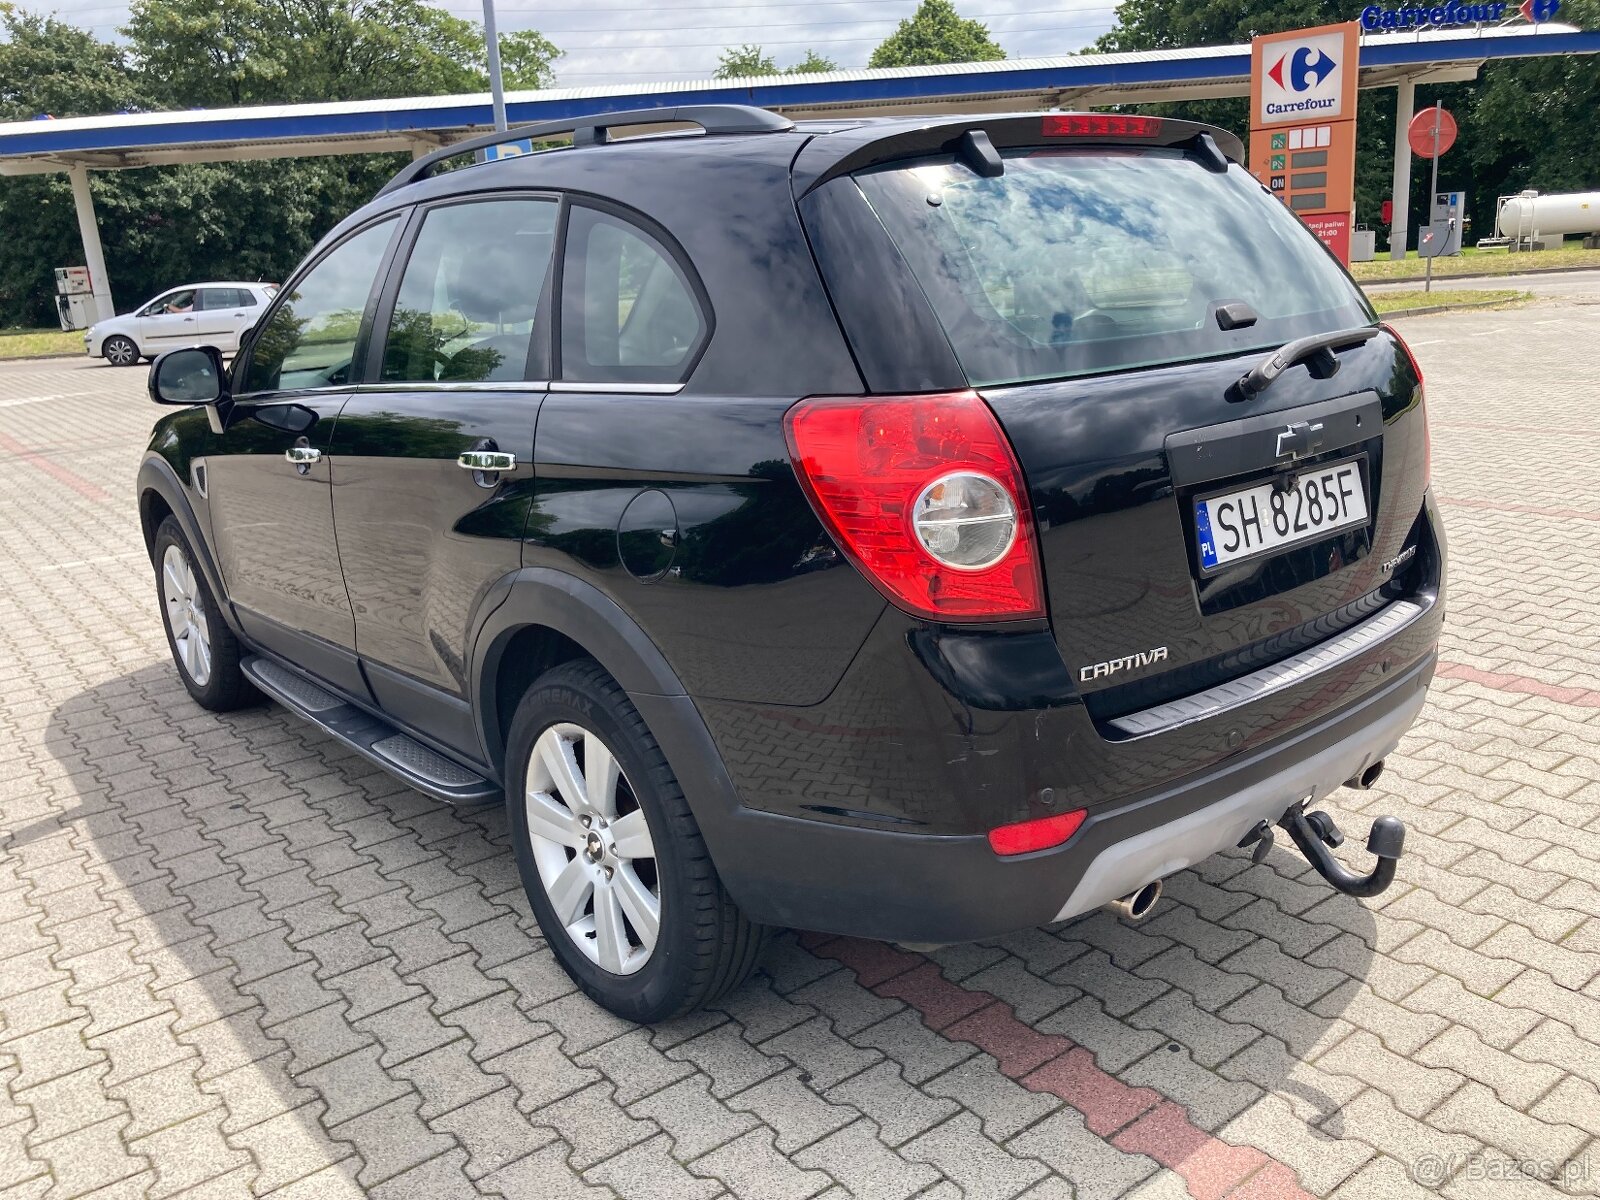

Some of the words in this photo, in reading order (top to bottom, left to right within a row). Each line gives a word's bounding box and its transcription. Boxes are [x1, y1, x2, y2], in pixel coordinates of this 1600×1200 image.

[1361, 0, 1507, 30] Carrefour
[1266, 98, 1336, 114] Carrefour
[1272, 178, 1285, 189] ON
[1308, 221, 1323, 229] tacji
[1318, 229, 1338, 237] 21:00
[1217, 495, 1263, 553] SH
[1270, 469, 1353, 537] 8285F
[1201, 543, 1214, 557] PL
[1079, 646, 1168, 682] CAPTIVA
